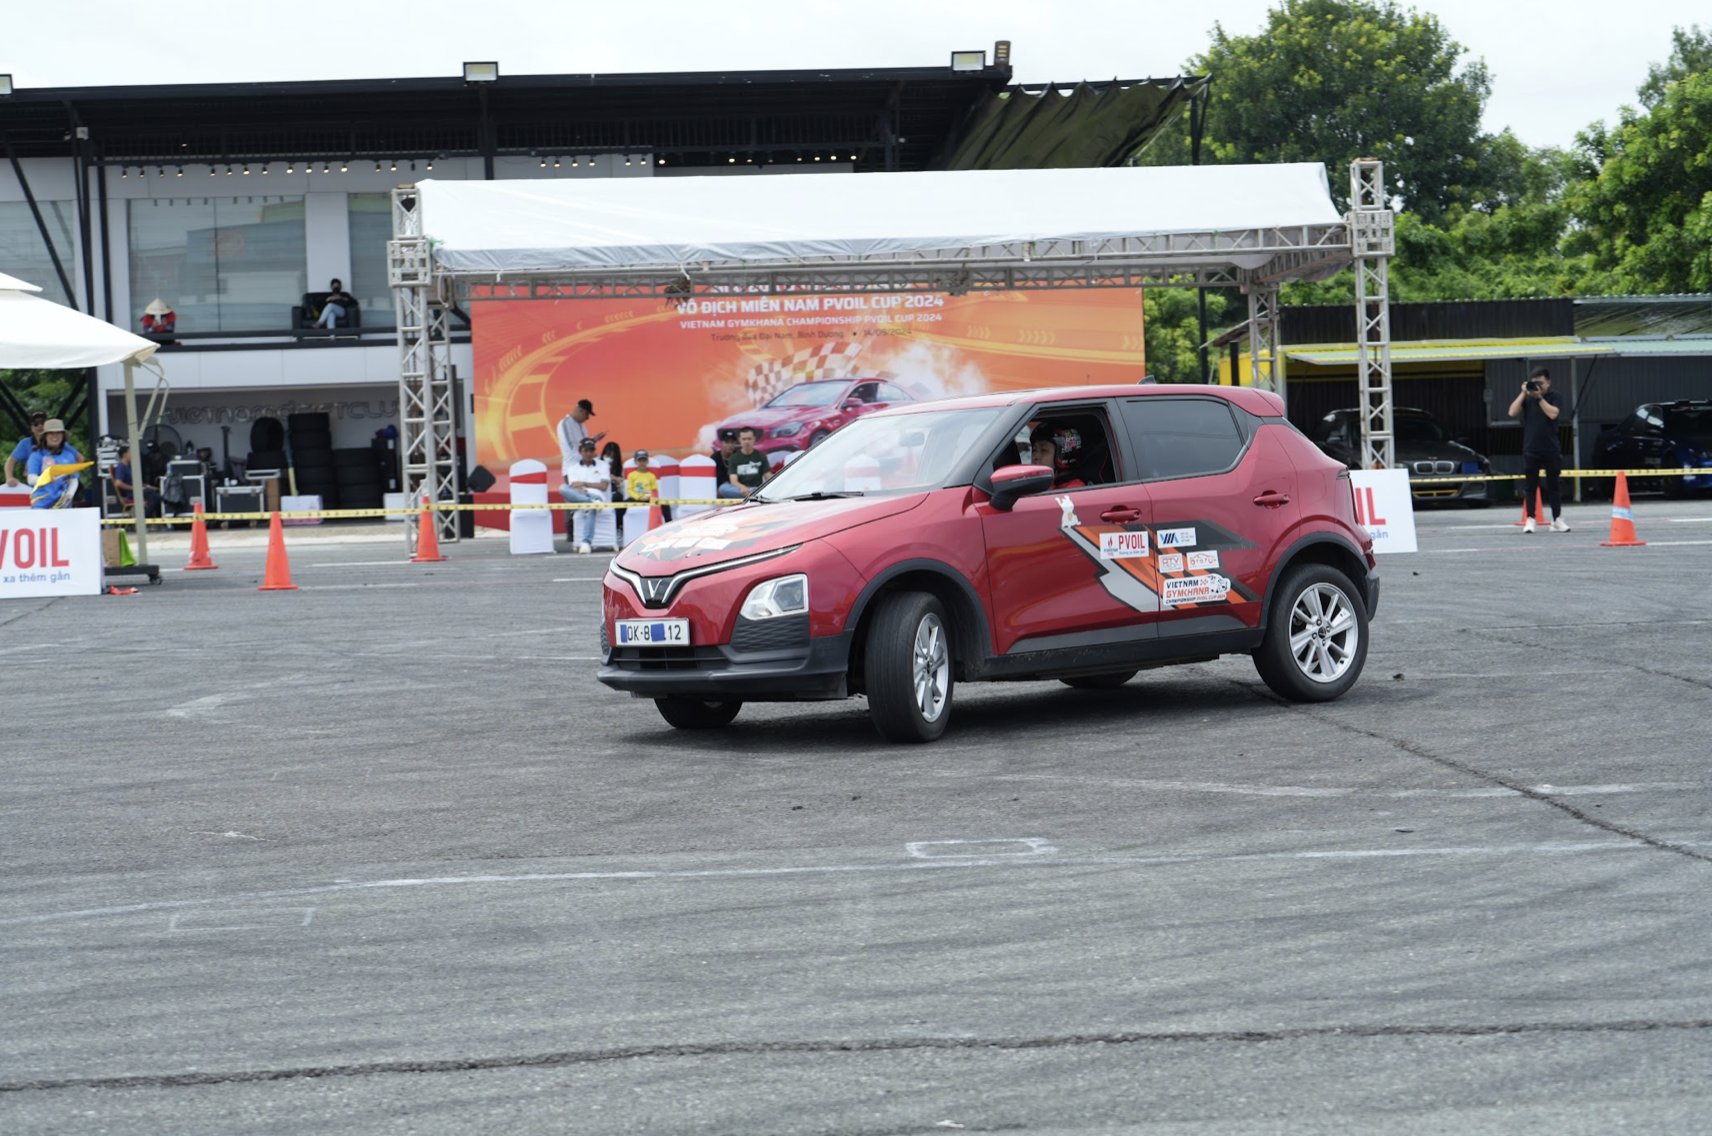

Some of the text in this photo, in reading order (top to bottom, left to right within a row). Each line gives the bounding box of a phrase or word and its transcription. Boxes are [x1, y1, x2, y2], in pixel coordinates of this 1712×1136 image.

[701, 300, 737, 316] ĐỊCH
[784, 298, 820, 312] NAM
[823, 297, 868, 311] PVOIL
[872, 295, 901, 309] CUP
[905, 294, 944, 308] 2024
[680, 313, 942, 329] VIETNAM GYMKHANA CHAMPIONSHIP PVOIL CUP 2024
[1118, 534, 1146, 550] PVOIL
[3, 575, 16, 583] xa
[19, 573, 46, 583] thêm
[1166, 580, 1199, 589] VIETNAM
[1166, 587, 1210, 599] GYMKHANA
